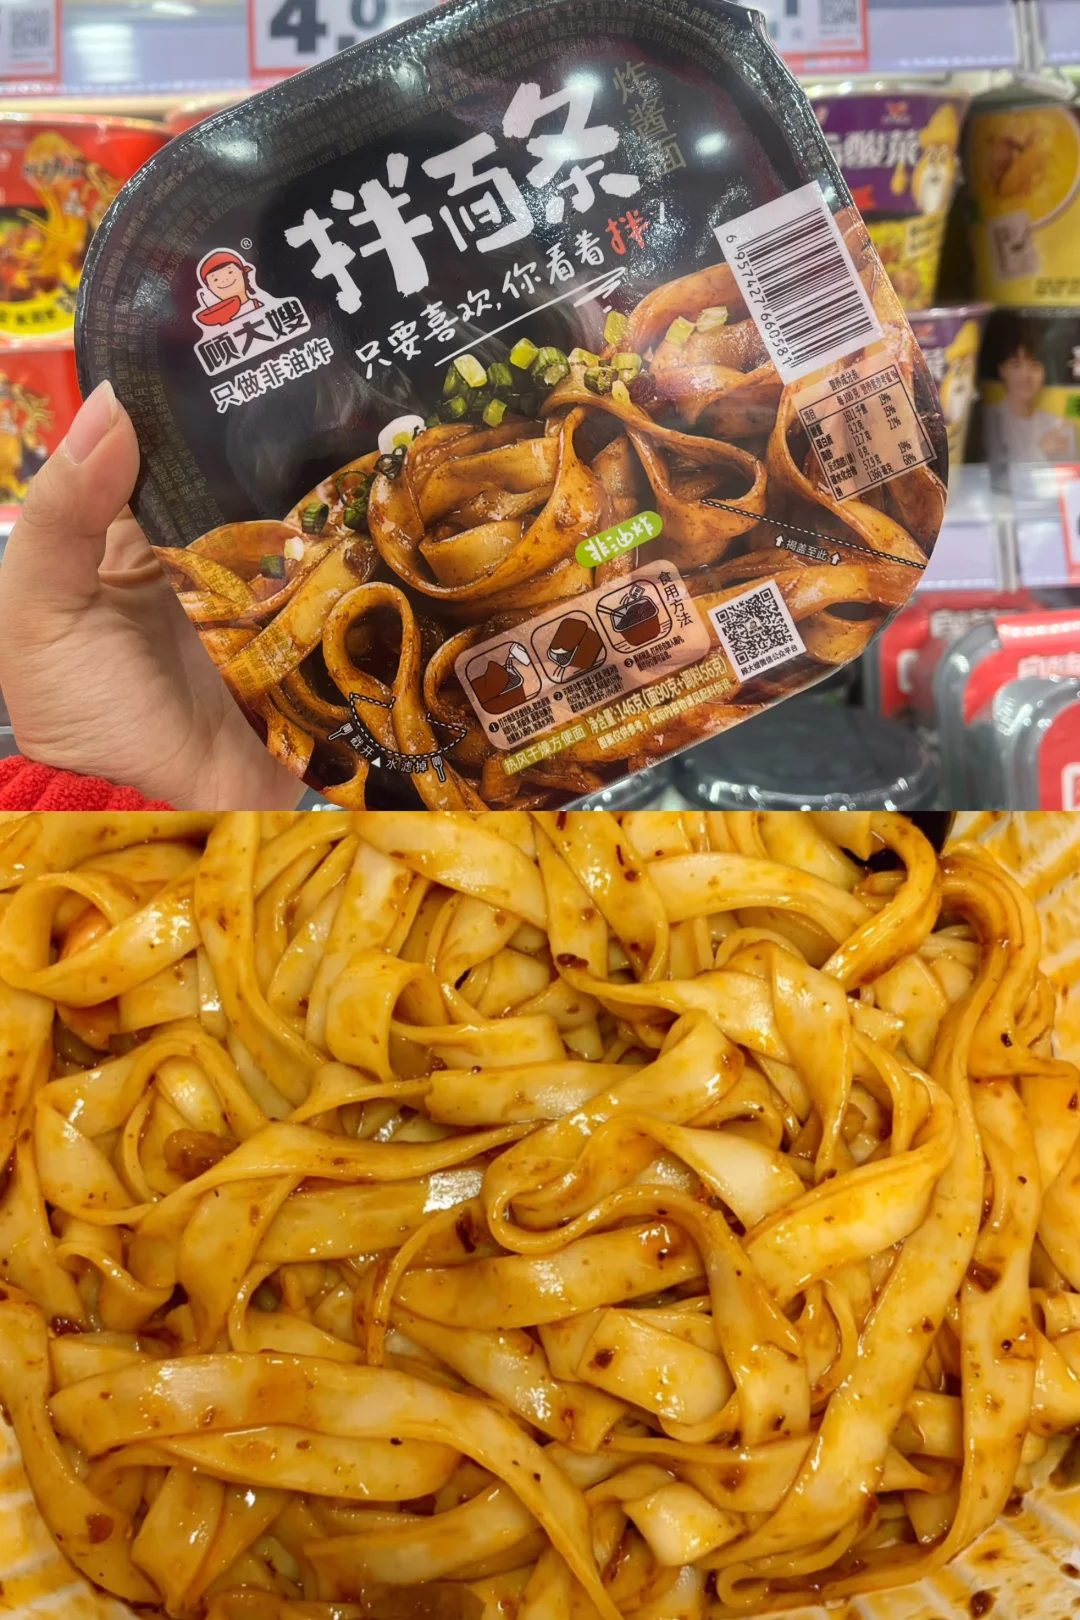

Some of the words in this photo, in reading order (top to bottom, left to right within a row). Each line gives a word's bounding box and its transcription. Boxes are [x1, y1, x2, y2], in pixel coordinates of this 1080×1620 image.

[196, 298, 308, 372] 顾大嫂
[209, 337, 334, 414] 只做非油炸
[785, 538, 828, 561] 揭盖至此
[655, 569, 693, 628] 食用方法
[740, 644, 797, 675] 顾大嫂微信公众平台
[502, 725, 586, 773] 热风干燥方便面
